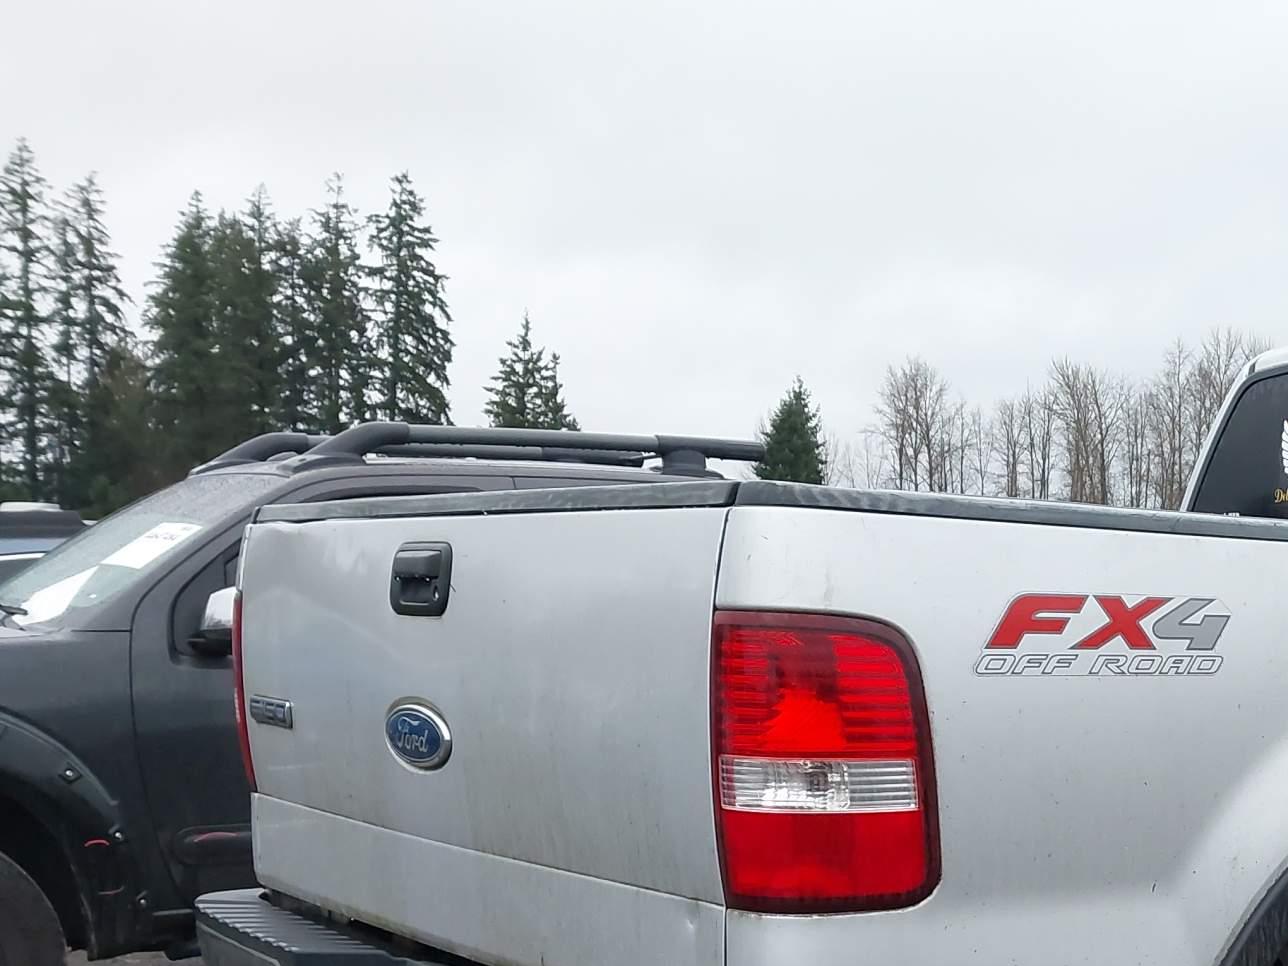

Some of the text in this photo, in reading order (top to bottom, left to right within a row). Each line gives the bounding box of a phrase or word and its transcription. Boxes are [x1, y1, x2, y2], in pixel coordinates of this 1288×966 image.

[984, 592, 1231, 651] FX4
[975, 653, 1224, 675] OFF ROAD
[396, 716, 428, 752] Ford
